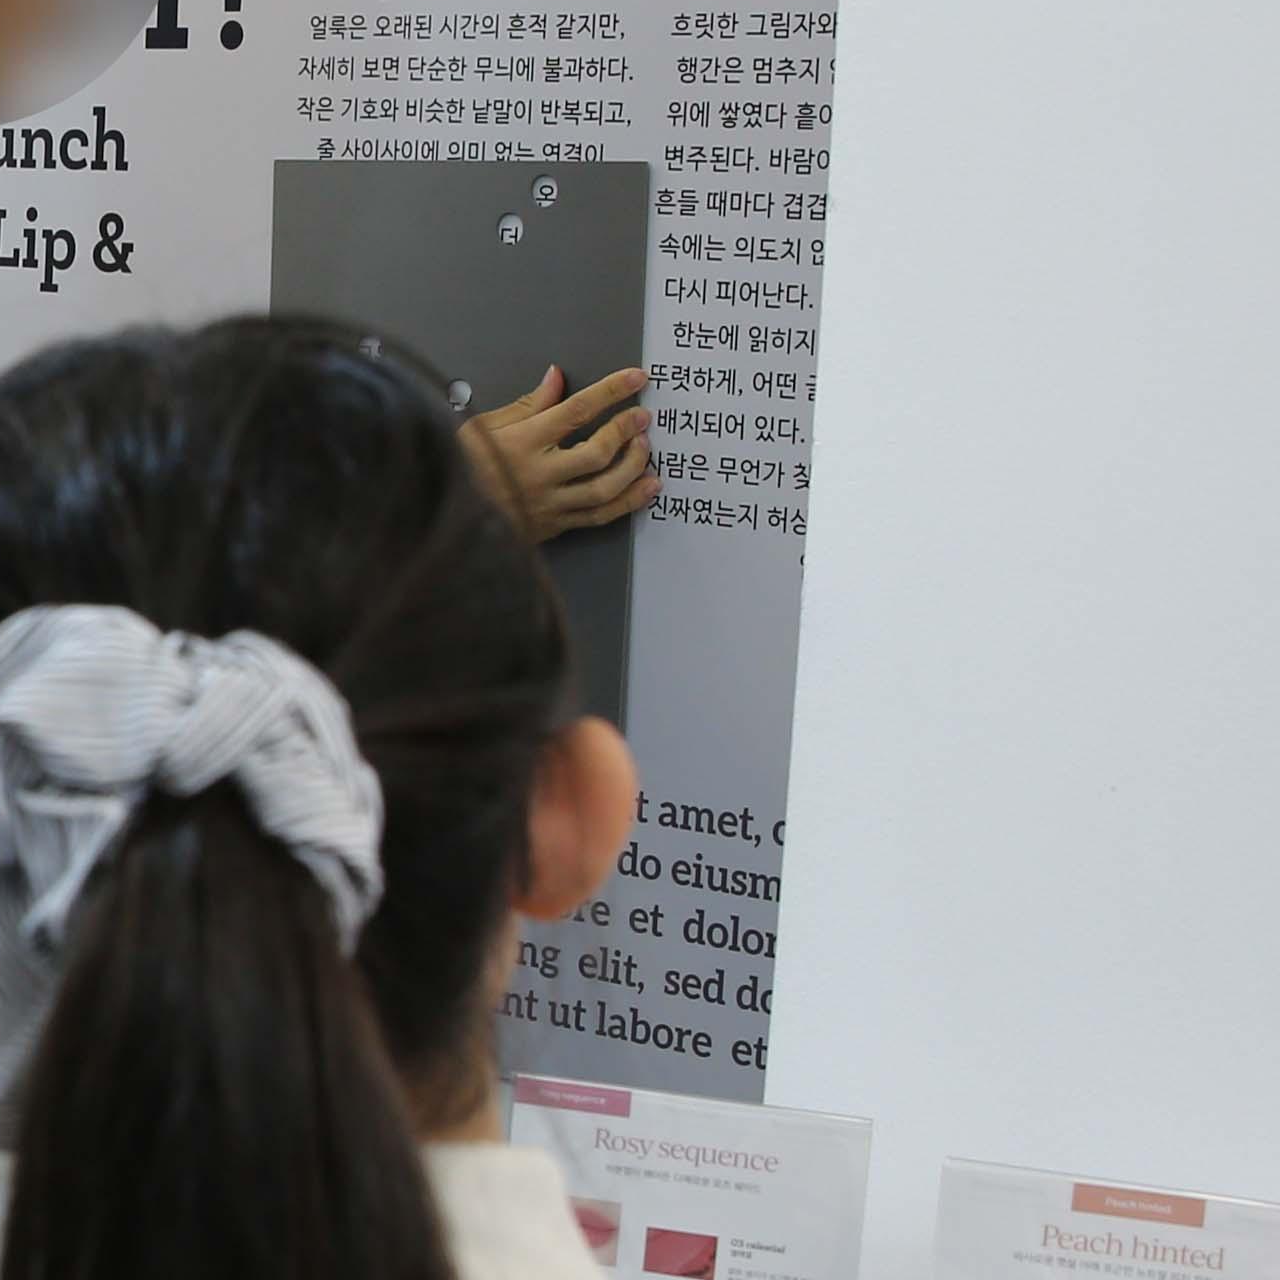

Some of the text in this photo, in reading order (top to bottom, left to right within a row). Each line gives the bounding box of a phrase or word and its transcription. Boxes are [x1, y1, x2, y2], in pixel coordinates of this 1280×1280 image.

[310, 13, 625, 41] 얼룩은 오래된 시간의 흔적 같지만,
[670, 11, 838, 40] 흐릿한 그림자와
[298, 55, 634, 83] 자세히 보면 단순한 무늬에 불과하다.
[677, 56, 745, 84] 행간은
[752, 56, 820, 85] 멈추지
[296, 96, 632, 127] 작은 기호와 비슷한 낱말이 반복되고,
[666, 101, 710, 129] 위에
[718, 101, 788, 129] 쌓였다
[664, 145, 760, 174] 변주된다.
[654, 187, 700, 217] 흔들
[706, 190, 775, 219] 때마다
[93, 212, 134, 274] &
[658, 233, 726, 262] 속에는
[733, 236, 801, 266] 의도치
[664, 277, 814, 311] 다시 피어난다.
[672, 320, 816, 357] 한눈에 읽히지
[648, 364, 743, 396] 뚜렷하게,
[753, 371, 797, 399] 어떤
[657, 407, 805, 445] 배치되어 있다.
[717, 457, 785, 488] 무언가
[648, 495, 758, 530] 진짜였는지
[658, 801, 762, 848] amet,
[617, 842, 661, 879] do
[629, 905, 663, 937] et
[578, 947, 645, 994] elit,
[664, 969, 725, 1005] sed
[549, 1000, 586, 1031] ut
[596, 1001, 712, 1057] labore
[732, 1038, 767, 1070] et
[594, 1128, 779, 1173] Rosy sequence
[1042, 1224, 1123, 1256] Peach
[1132, 1235, 1224, 1270] hinted
